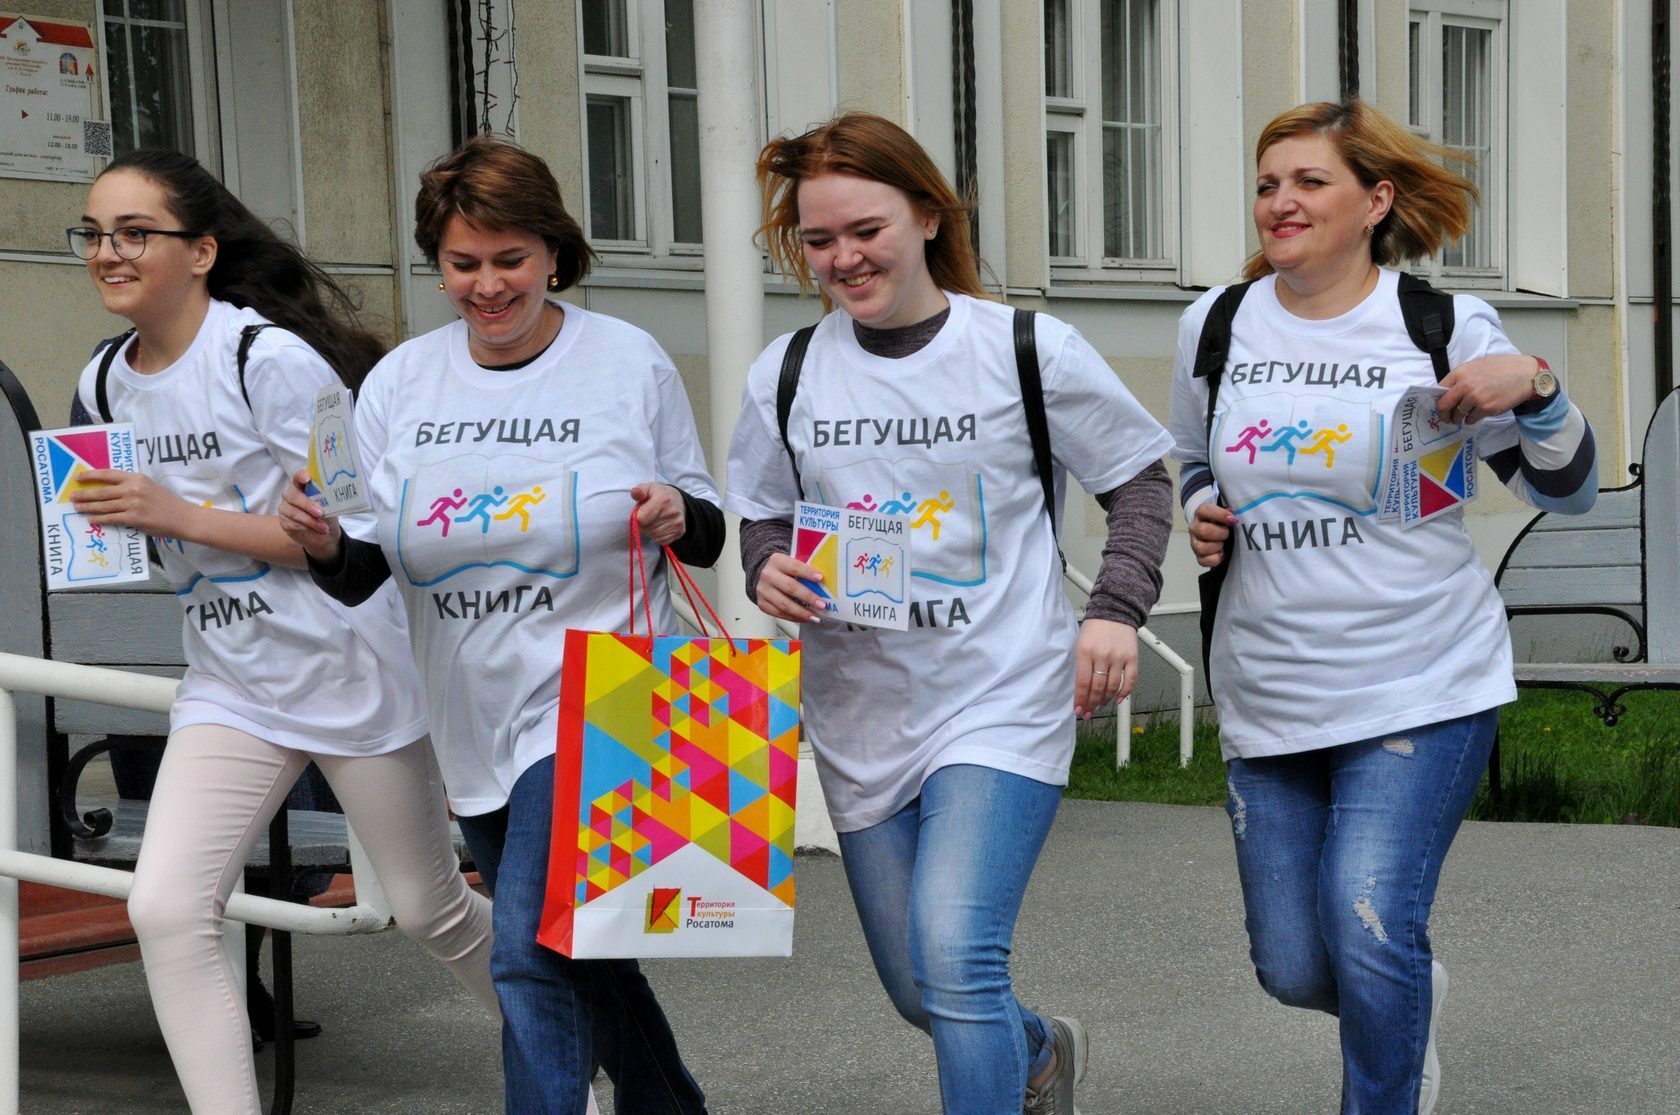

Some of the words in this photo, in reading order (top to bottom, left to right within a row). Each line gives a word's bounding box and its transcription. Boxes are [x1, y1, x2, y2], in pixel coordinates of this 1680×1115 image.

[1231, 360, 1387, 389] БЕГУЩАЯ
[317, 392, 341, 414] БЕГУЩАЯ
[415, 418, 580, 447] БЕГУЩАЯ
[813, 413, 976, 449] БЕГУЩАЯ
[1403, 396, 1418, 452] БЕГУЩАЯ
[110, 432, 123, 469] КУЛЬТ
[35, 437, 53, 504] РОСАТОМА
[1383, 458, 1399, 514] ТЕРРИТОРИЯ
[333, 483, 358, 503] КНИГА
[1403, 463, 1411, 523] ТЕРРИТОРИЯ
[1410, 460, 1418, 520] КУЛЬТУРЫ
[799, 515, 839, 532] КУЛЬТУРЫ
[800, 505, 840, 520] ТЕРРИТОРИЯ
[848, 515, 903, 535] БЕГУЩАЯ
[1242, 517, 1364, 551] КНИГА
[47, 524, 63, 576] КНИГА
[432, 585, 554, 619] КНИГА
[853, 602, 897, 622] КНИГА
[687, 897, 736, 917] Территория
[686, 919, 734, 928] Росатома
